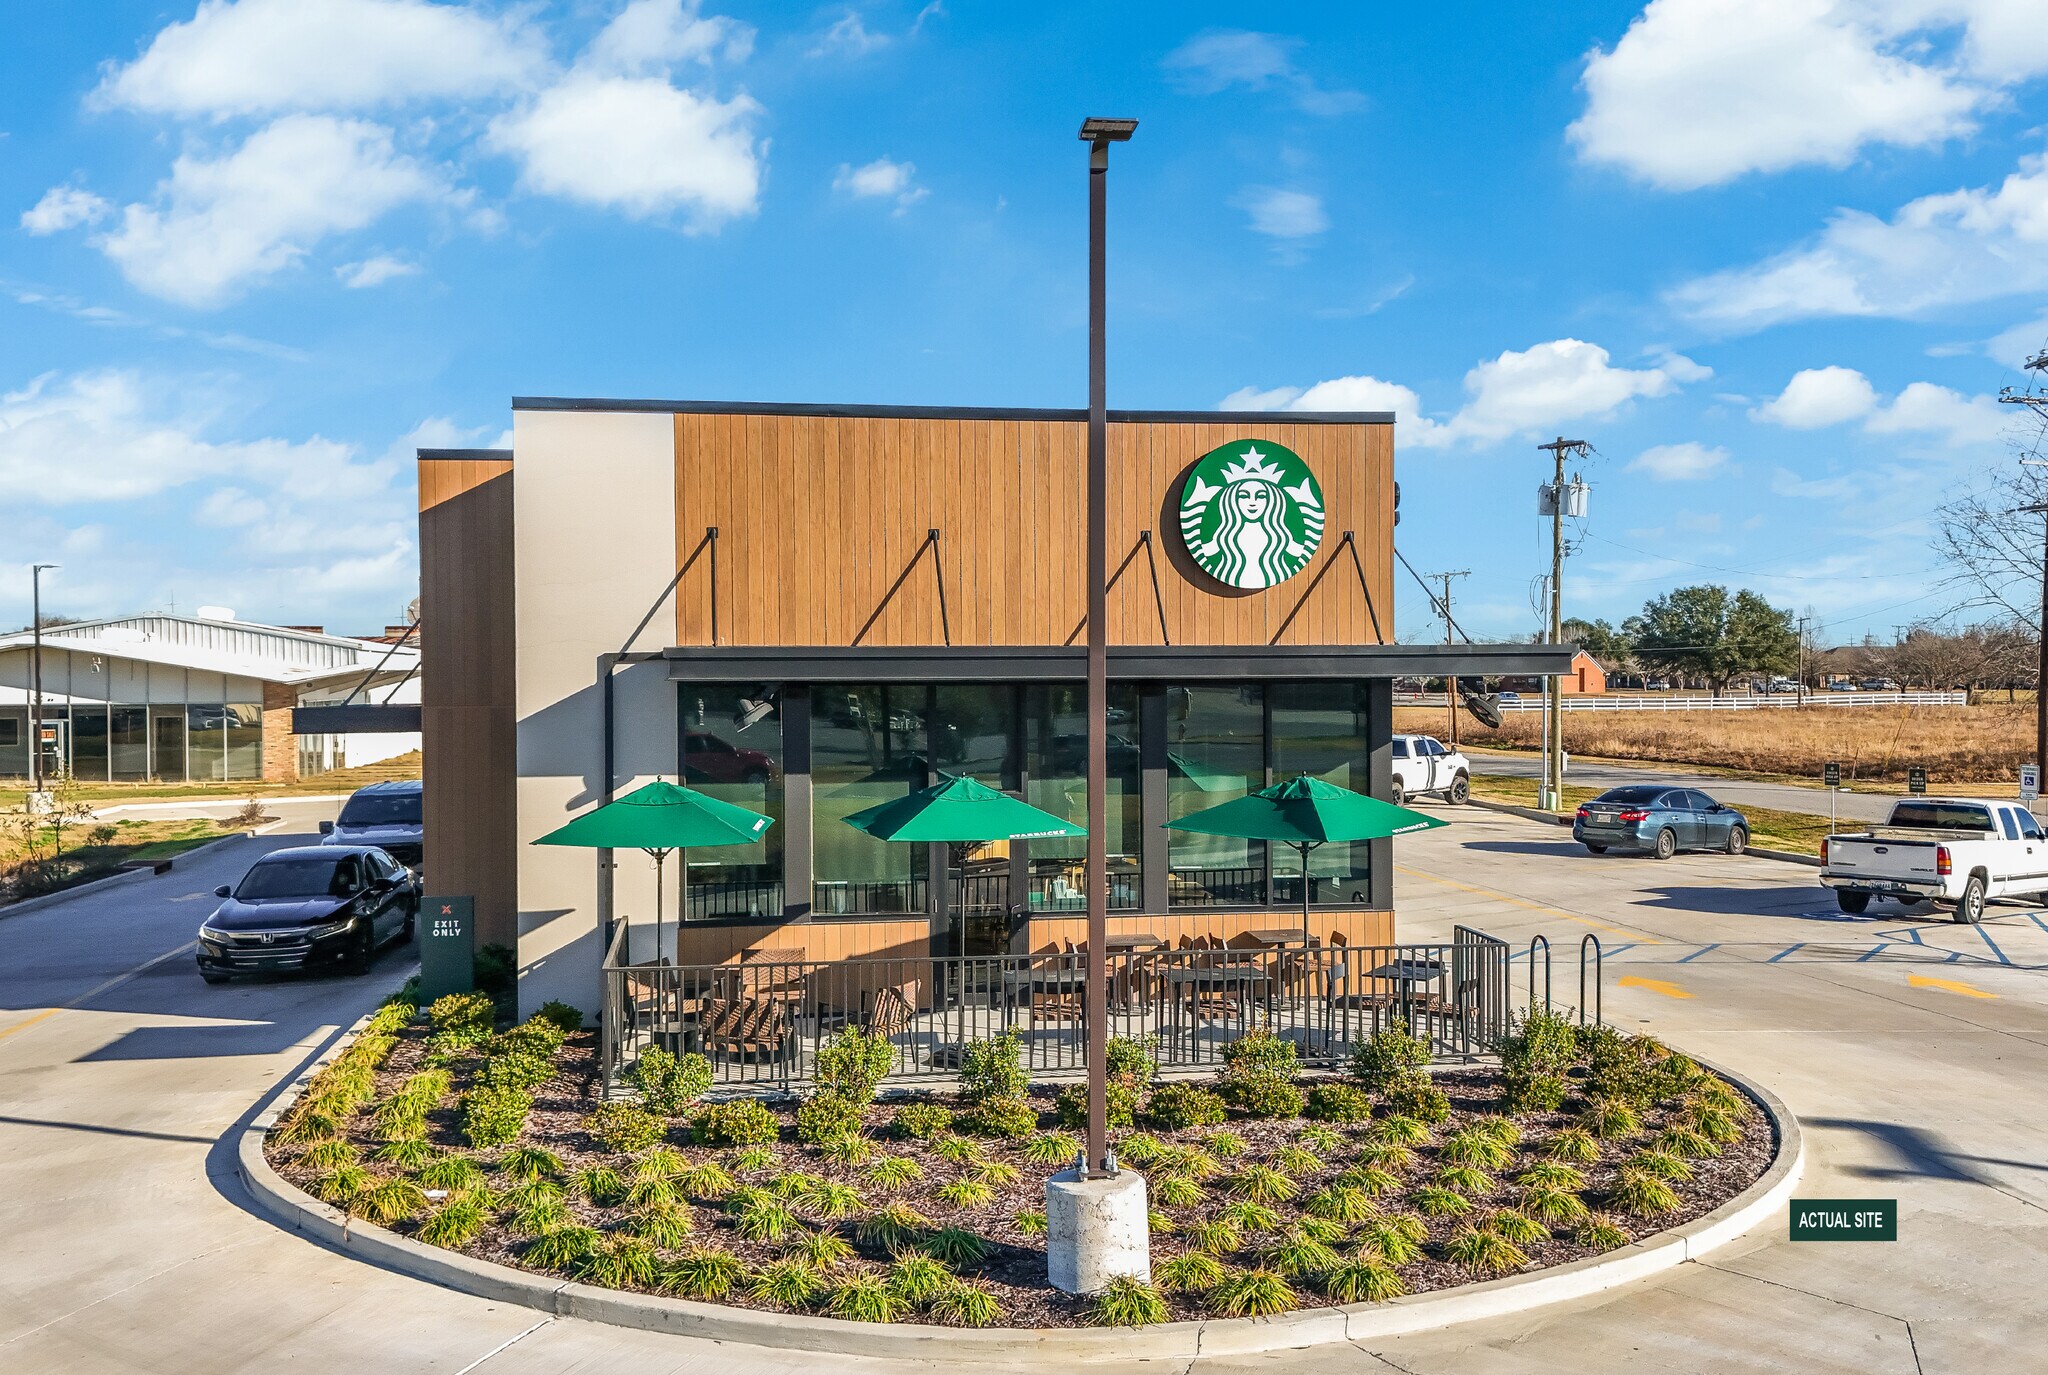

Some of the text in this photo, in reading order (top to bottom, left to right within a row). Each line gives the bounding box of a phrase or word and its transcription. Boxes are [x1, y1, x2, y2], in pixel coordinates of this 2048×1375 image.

[1009, 829, 1066, 838] STARBUCKS
[434, 920, 459, 928] EXIT
[432, 928, 461, 937] ONLY
